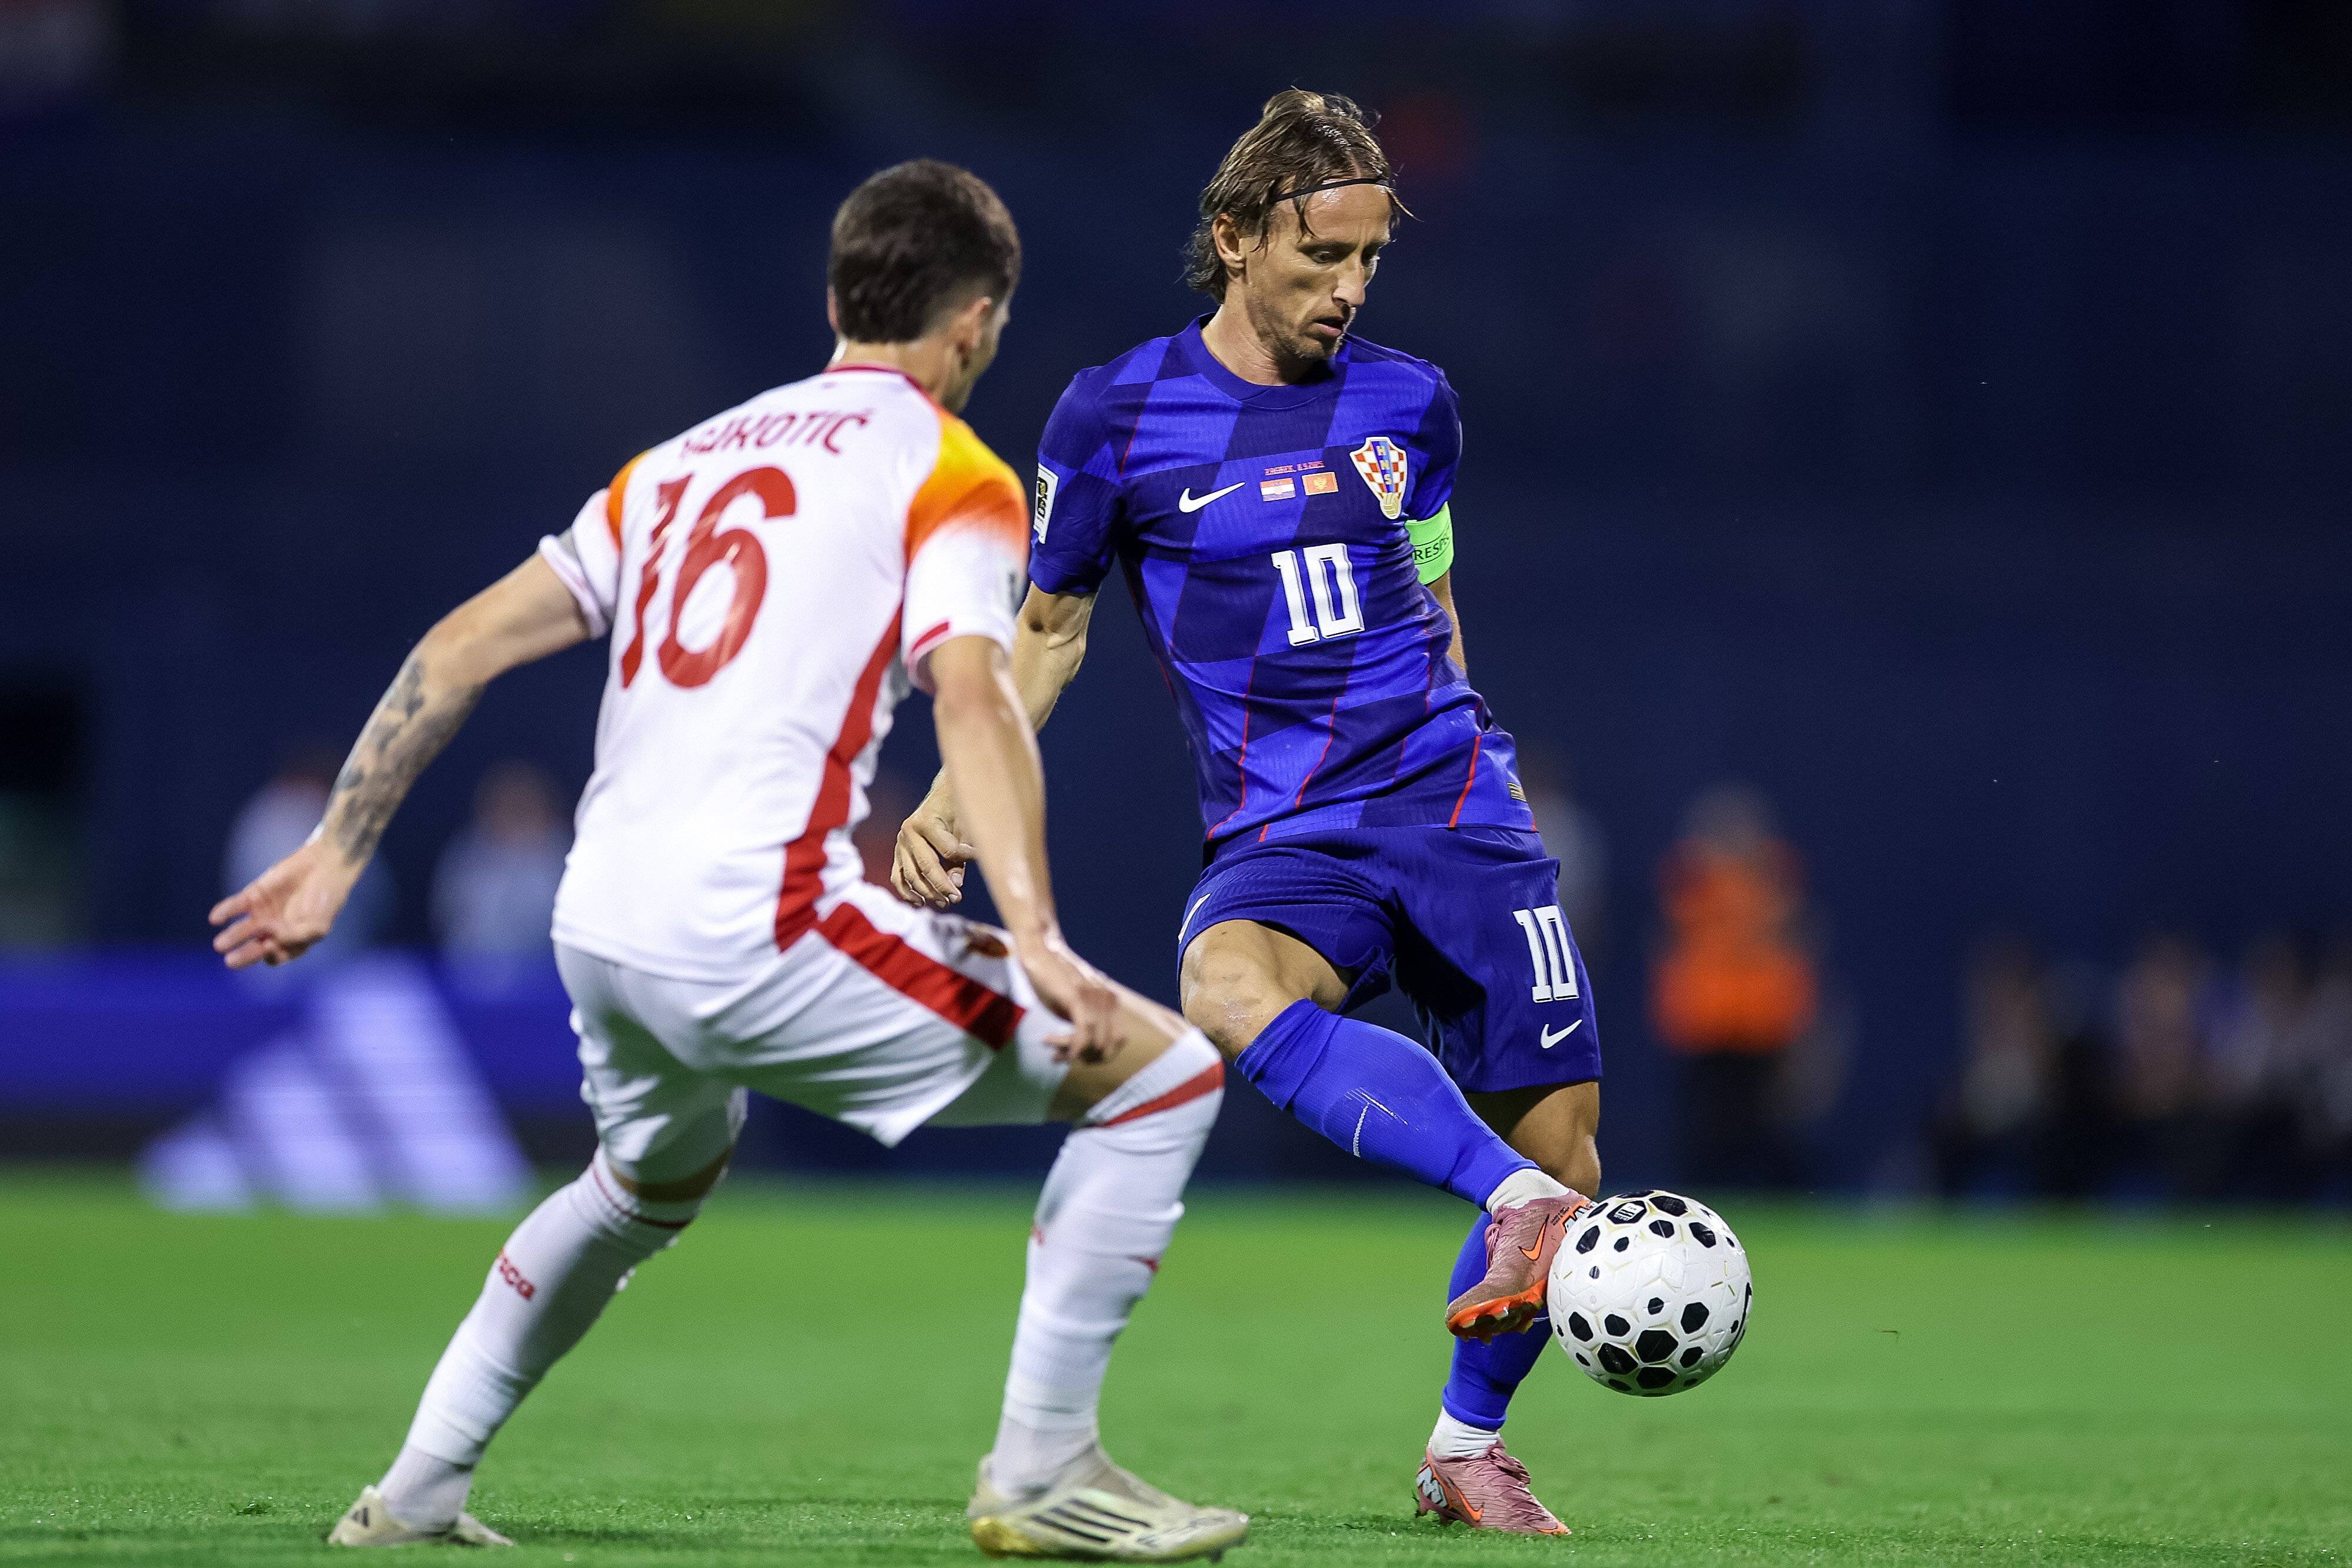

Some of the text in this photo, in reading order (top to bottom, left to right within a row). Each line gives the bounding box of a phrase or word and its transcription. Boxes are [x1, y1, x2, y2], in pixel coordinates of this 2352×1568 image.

[622, 466, 796, 688] 16
[1271, 543, 1365, 646] 10
[1512, 905, 1579, 1002] 10
